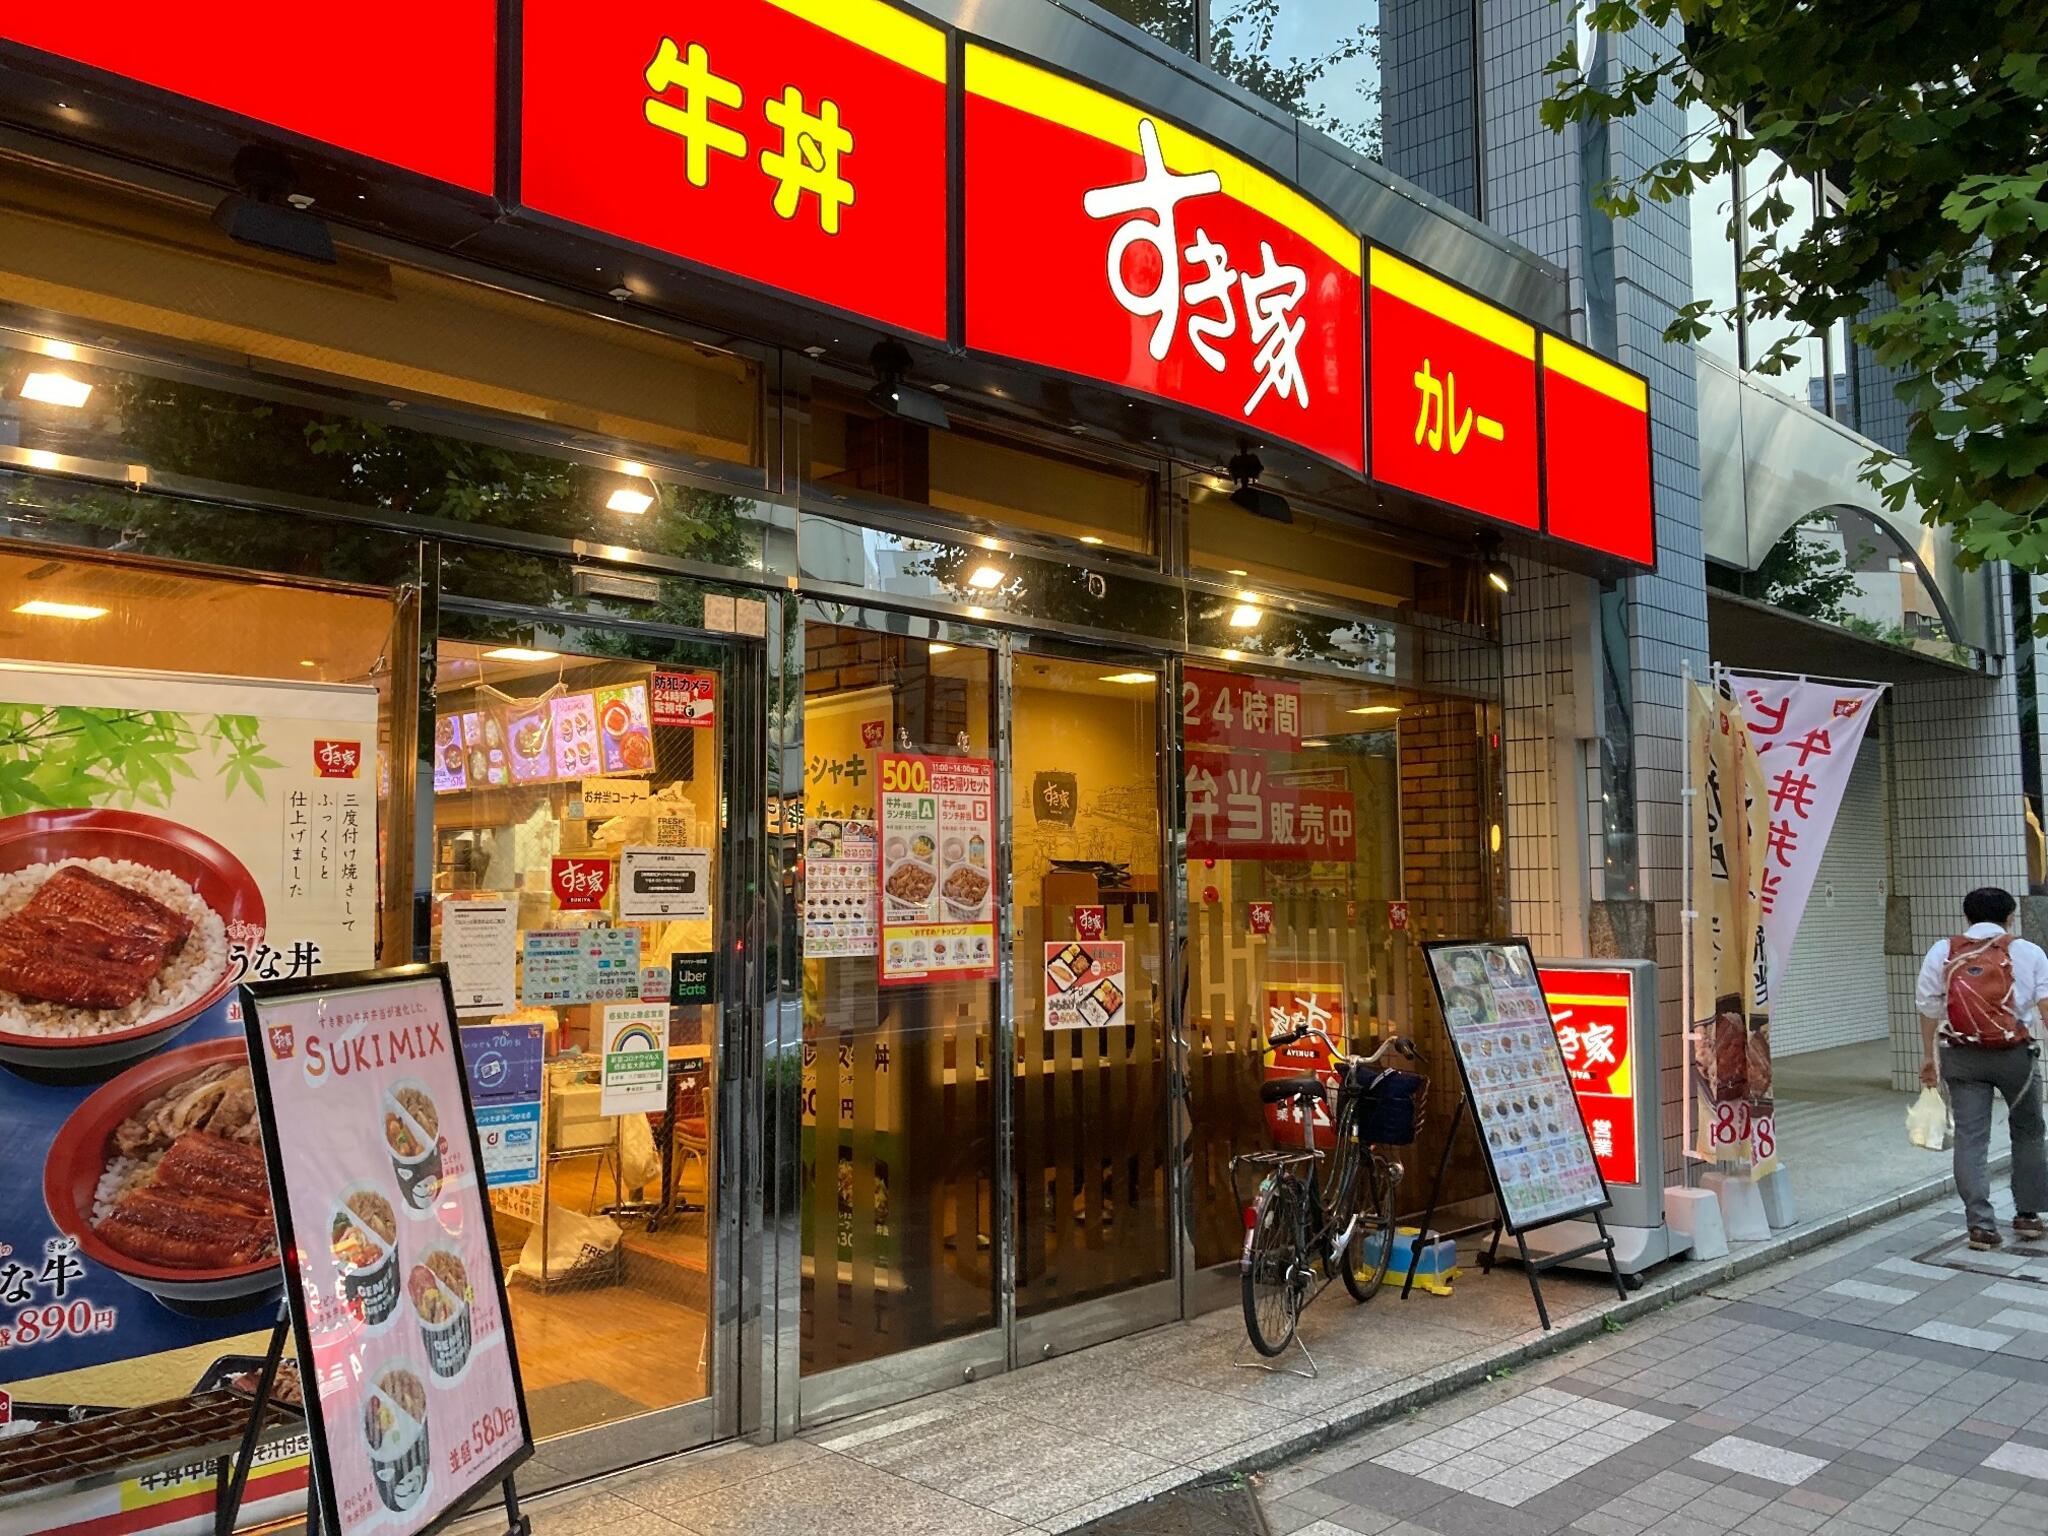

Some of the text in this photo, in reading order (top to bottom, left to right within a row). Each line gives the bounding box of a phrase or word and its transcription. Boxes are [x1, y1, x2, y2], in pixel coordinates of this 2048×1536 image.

[644, 35, 856, 235] 牛丼
[1083, 118, 1310, 416] すき家
[1414, 358, 1505, 455] カレー
[655, 676, 711, 692] 防犯カメラ
[655, 690, 690, 703] 24時間
[655, 701, 686, 714] 監視中
[1183, 681, 1299, 737] 24時間
[319, 743, 356, 768] すき家
[803, 753, 867, 787] シャキ
[584, 791, 648, 804] お弁当コーナー
[932, 776, 989, 793] お持ち帰りセット
[886, 810, 918, 820] ランチ弁当
[921, 802, 933, 818] A
[942, 811, 972, 821] ランチ弁当
[975, 803, 985, 818] B
[1185, 765, 1353, 847] 弁当販売中
[290, 791, 308, 898] 仕上げました
[317, 793, 334, 880] ふっくらと
[342, 793, 360, 932] 三度付け焼きして
[558, 861, 604, 896] すき家
[1080, 909, 1102, 932] すき家
[229, 941, 321, 984] うな丼
[679, 971, 707, 982] Uber
[679, 984, 707, 996] Eats
[305, 1022, 445, 1077] SUKIMIX
[1551, 1010, 1616, 1069] き家
[1592, 1119, 1613, 1158] 営業
[47, 1239, 77, 1253] ぎゅう
[0, 1254, 83, 1303] な牛
